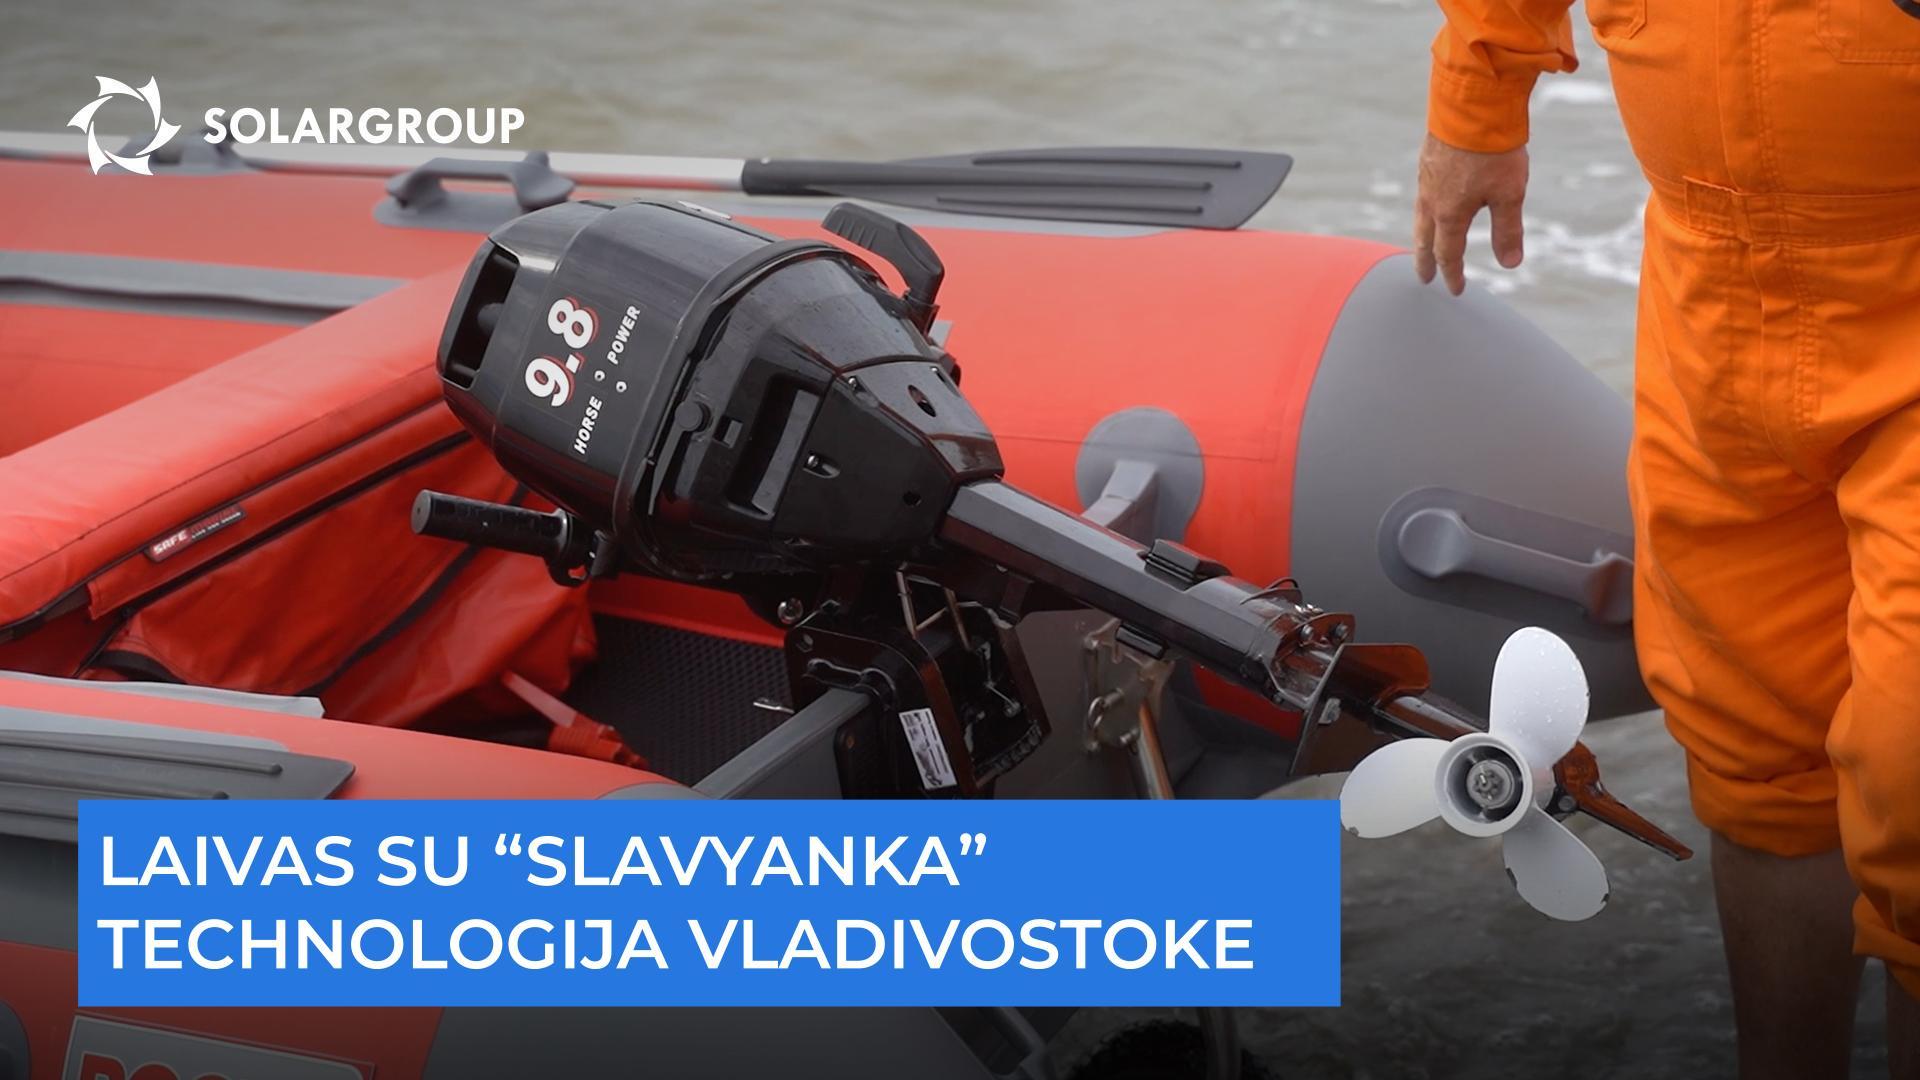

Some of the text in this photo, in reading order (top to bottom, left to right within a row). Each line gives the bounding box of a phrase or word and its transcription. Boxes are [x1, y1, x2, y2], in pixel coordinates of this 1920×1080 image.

[525, 297, 600, 407] 9.8
[573, 305, 641, 455] HORSE POWER
